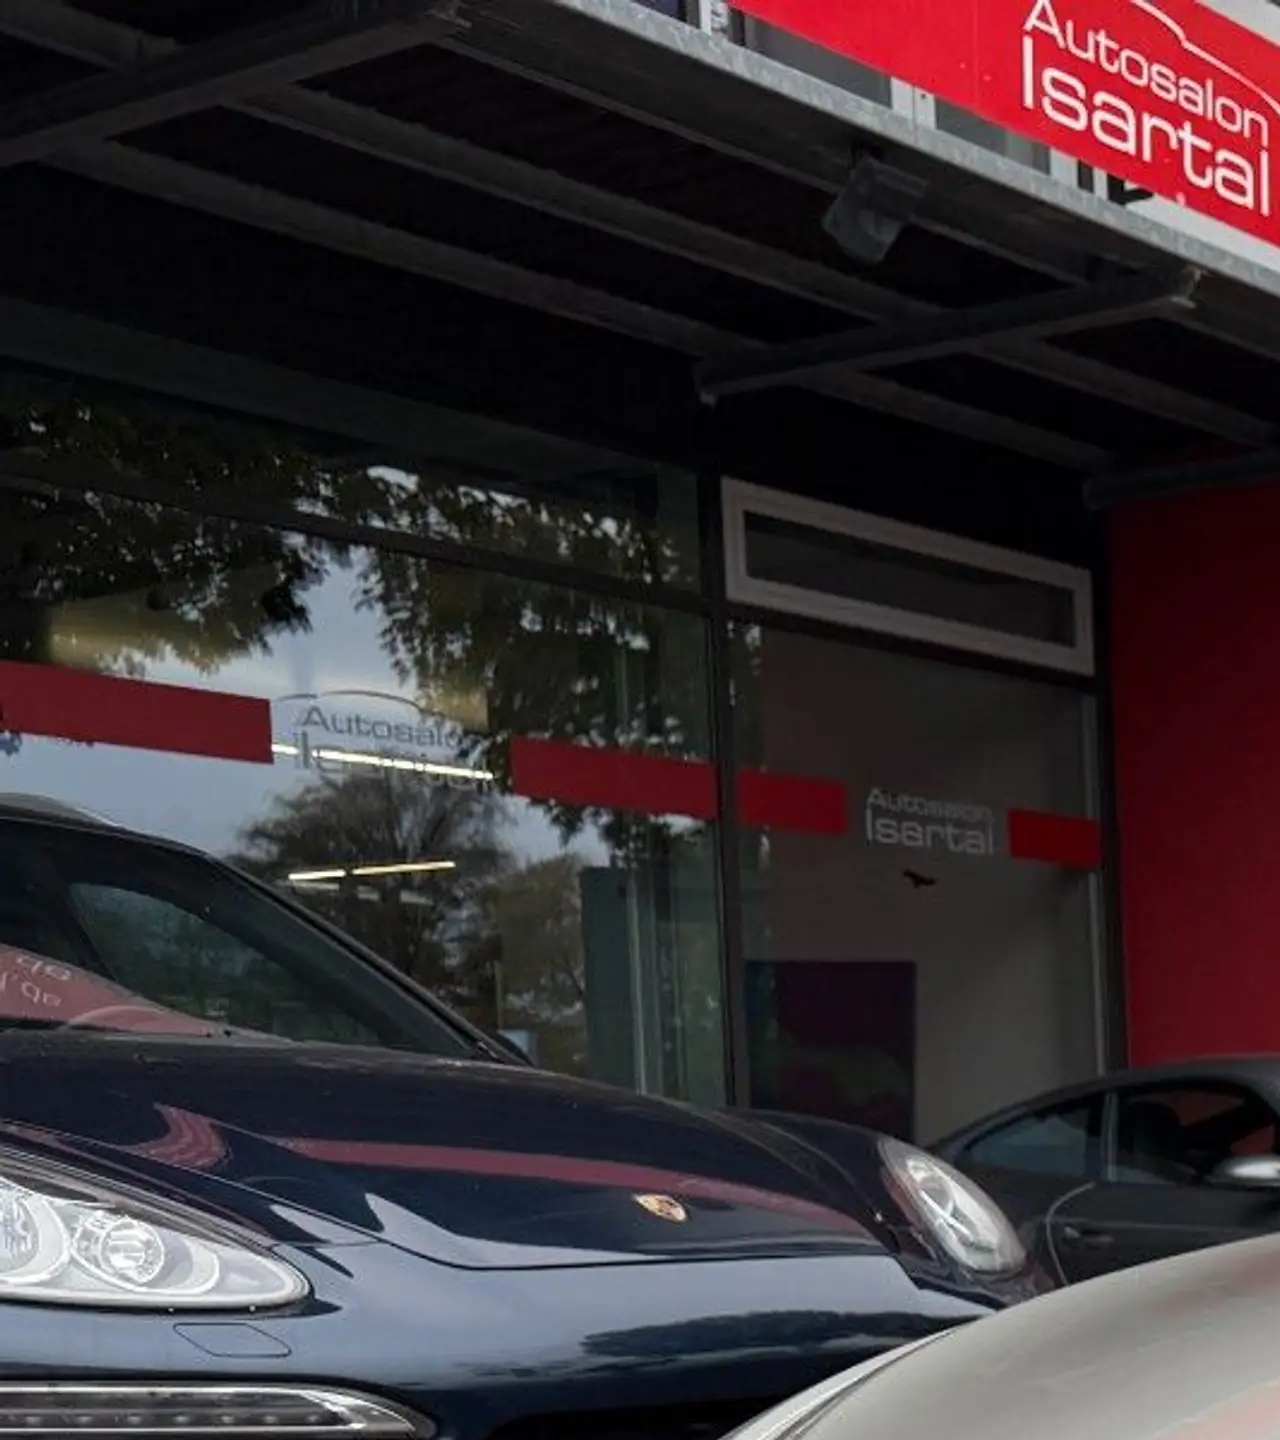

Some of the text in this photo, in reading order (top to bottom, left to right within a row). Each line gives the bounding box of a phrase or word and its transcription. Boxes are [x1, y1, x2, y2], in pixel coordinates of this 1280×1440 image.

[1022, 35, 1270, 216] Isartal
[1023, 0, 1269, 147] Autosalon
[866, 808, 994, 856] Isartal
